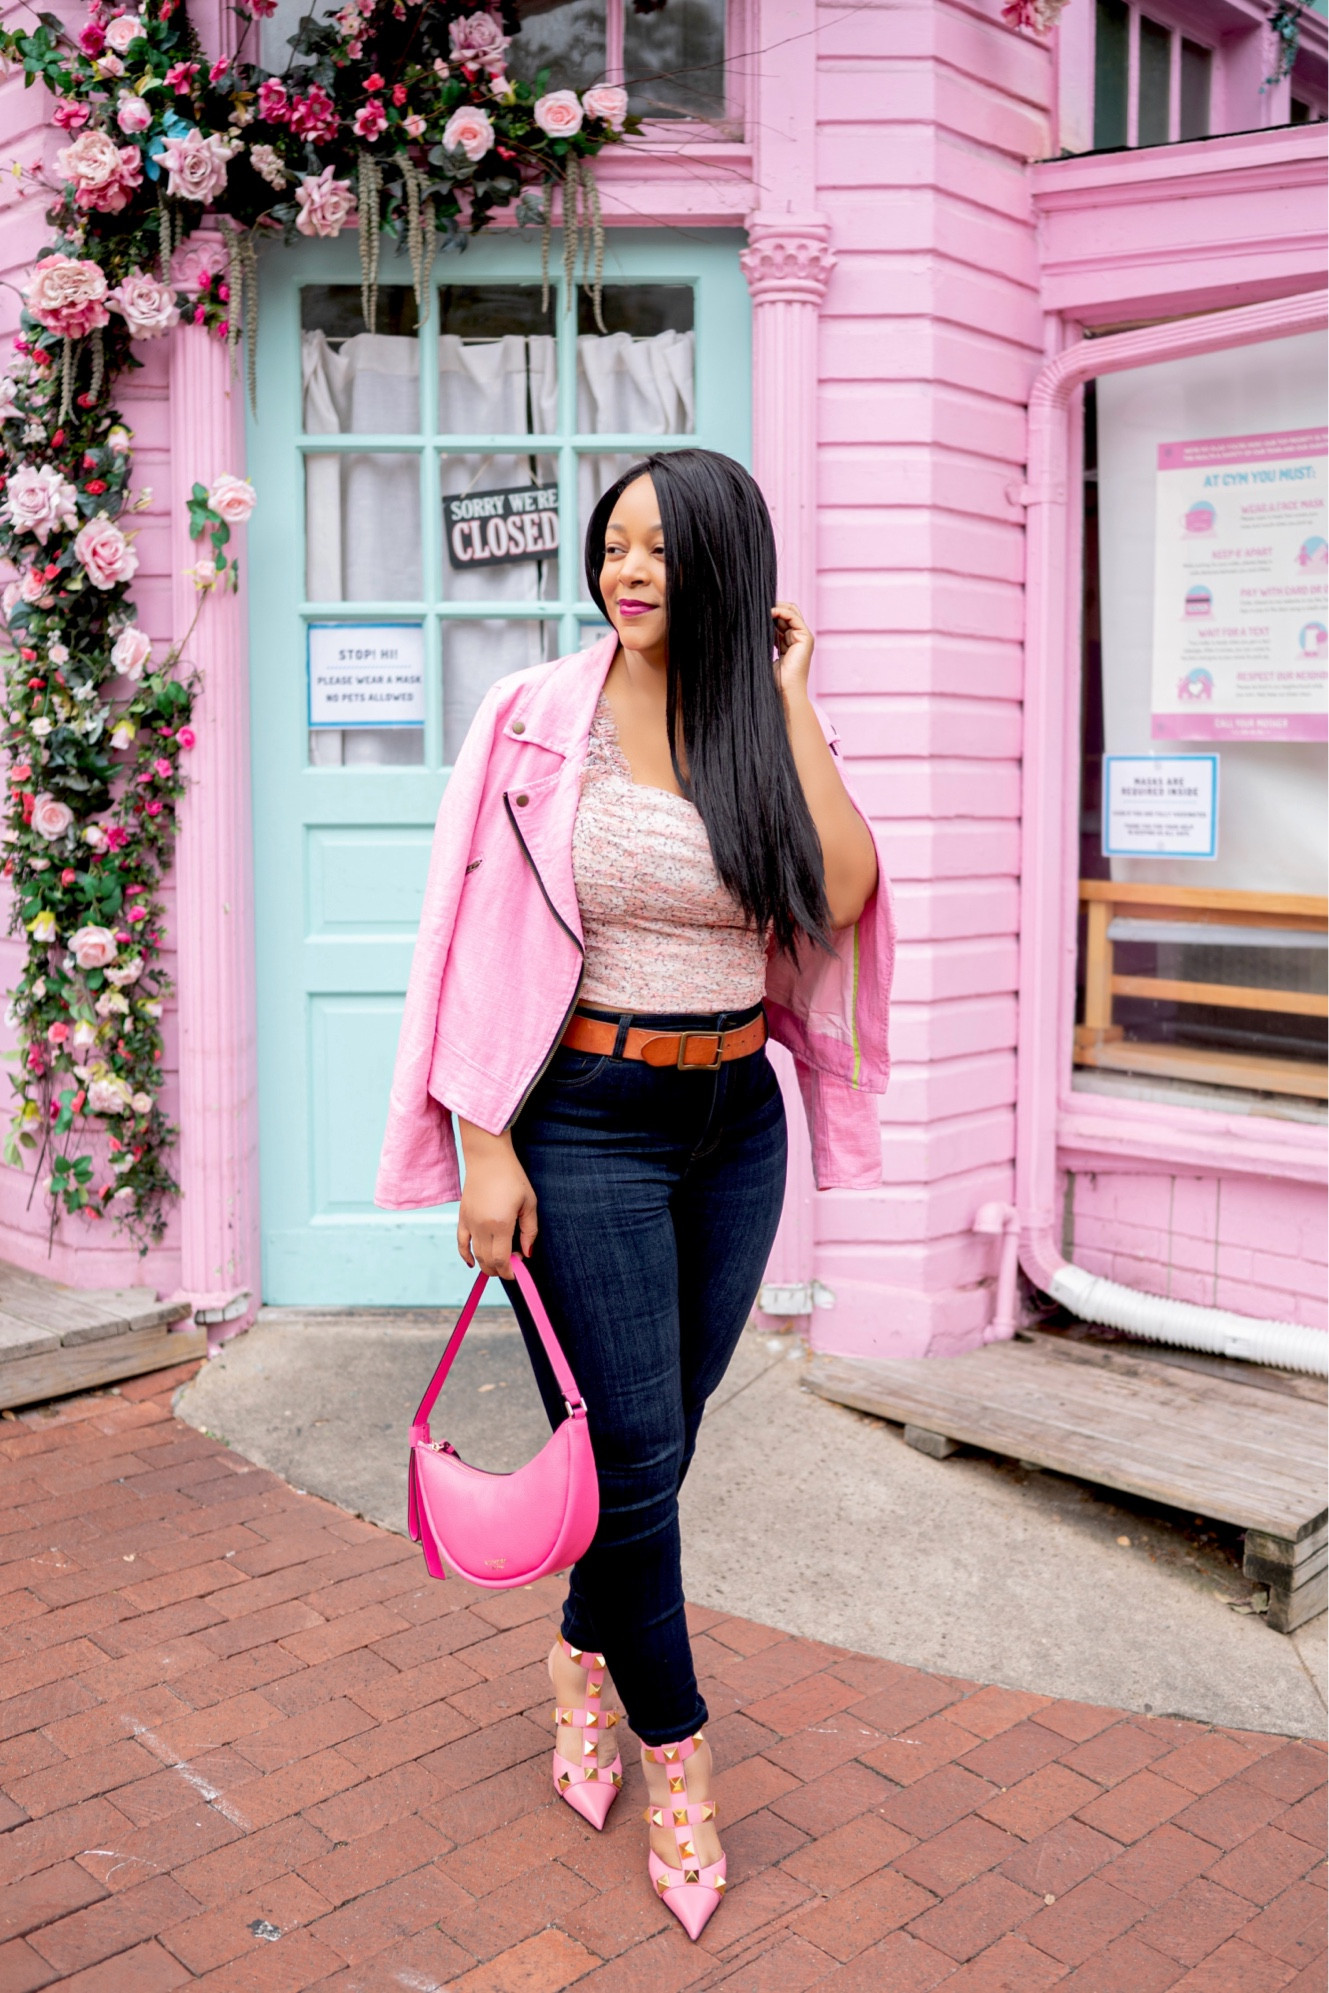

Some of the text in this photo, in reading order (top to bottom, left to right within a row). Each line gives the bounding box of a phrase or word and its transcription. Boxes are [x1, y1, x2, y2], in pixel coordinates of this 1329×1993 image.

[1203, 473, 1219, 488] AT
[1252, 470, 1276, 484] YOU
[1279, 466, 1316, 481] MUST:
[450, 489, 559, 521] SORRY WE'RE
[452, 511, 560, 561] CLOSED
[338, 648, 399, 661] STOP! HI!
[317, 675, 422, 686] PLEASE WEAR A MASK
[326, 693, 415, 703] NO PETS ALLOWED
[1134, 777, 1185, 786] MASKS ARE
[1121, 787, 1199, 796] REQUIRED INSIDE
